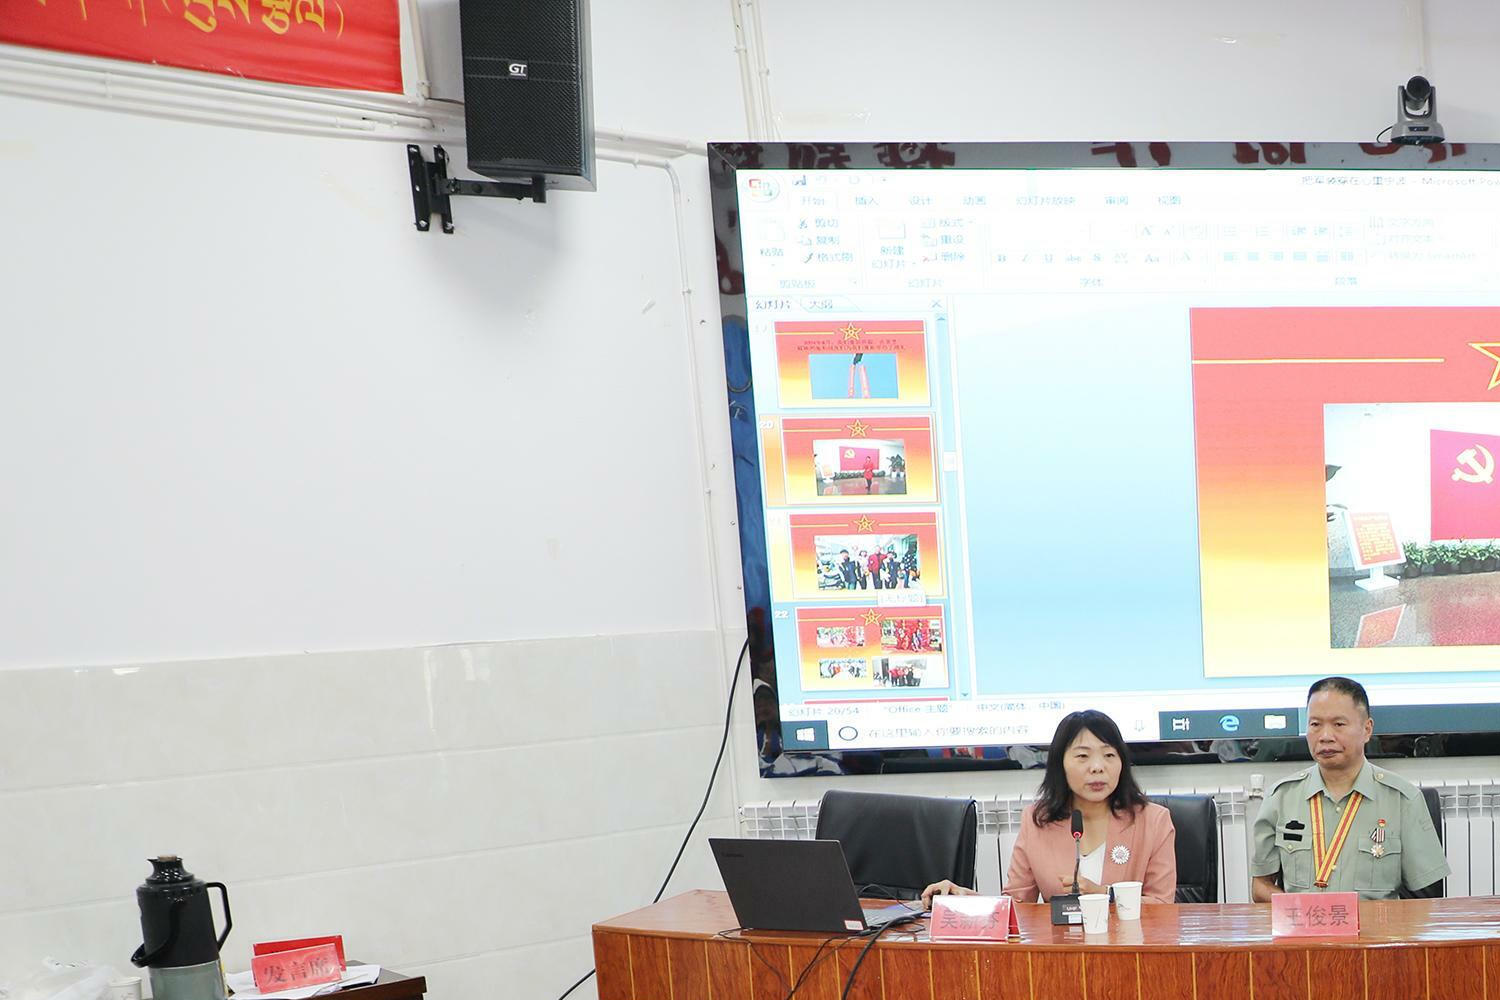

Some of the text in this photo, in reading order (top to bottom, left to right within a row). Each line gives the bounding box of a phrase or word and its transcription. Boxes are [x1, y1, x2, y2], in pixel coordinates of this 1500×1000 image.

[509, 63, 527, 74] GT
[263, 957, 335, 986] 发言席
